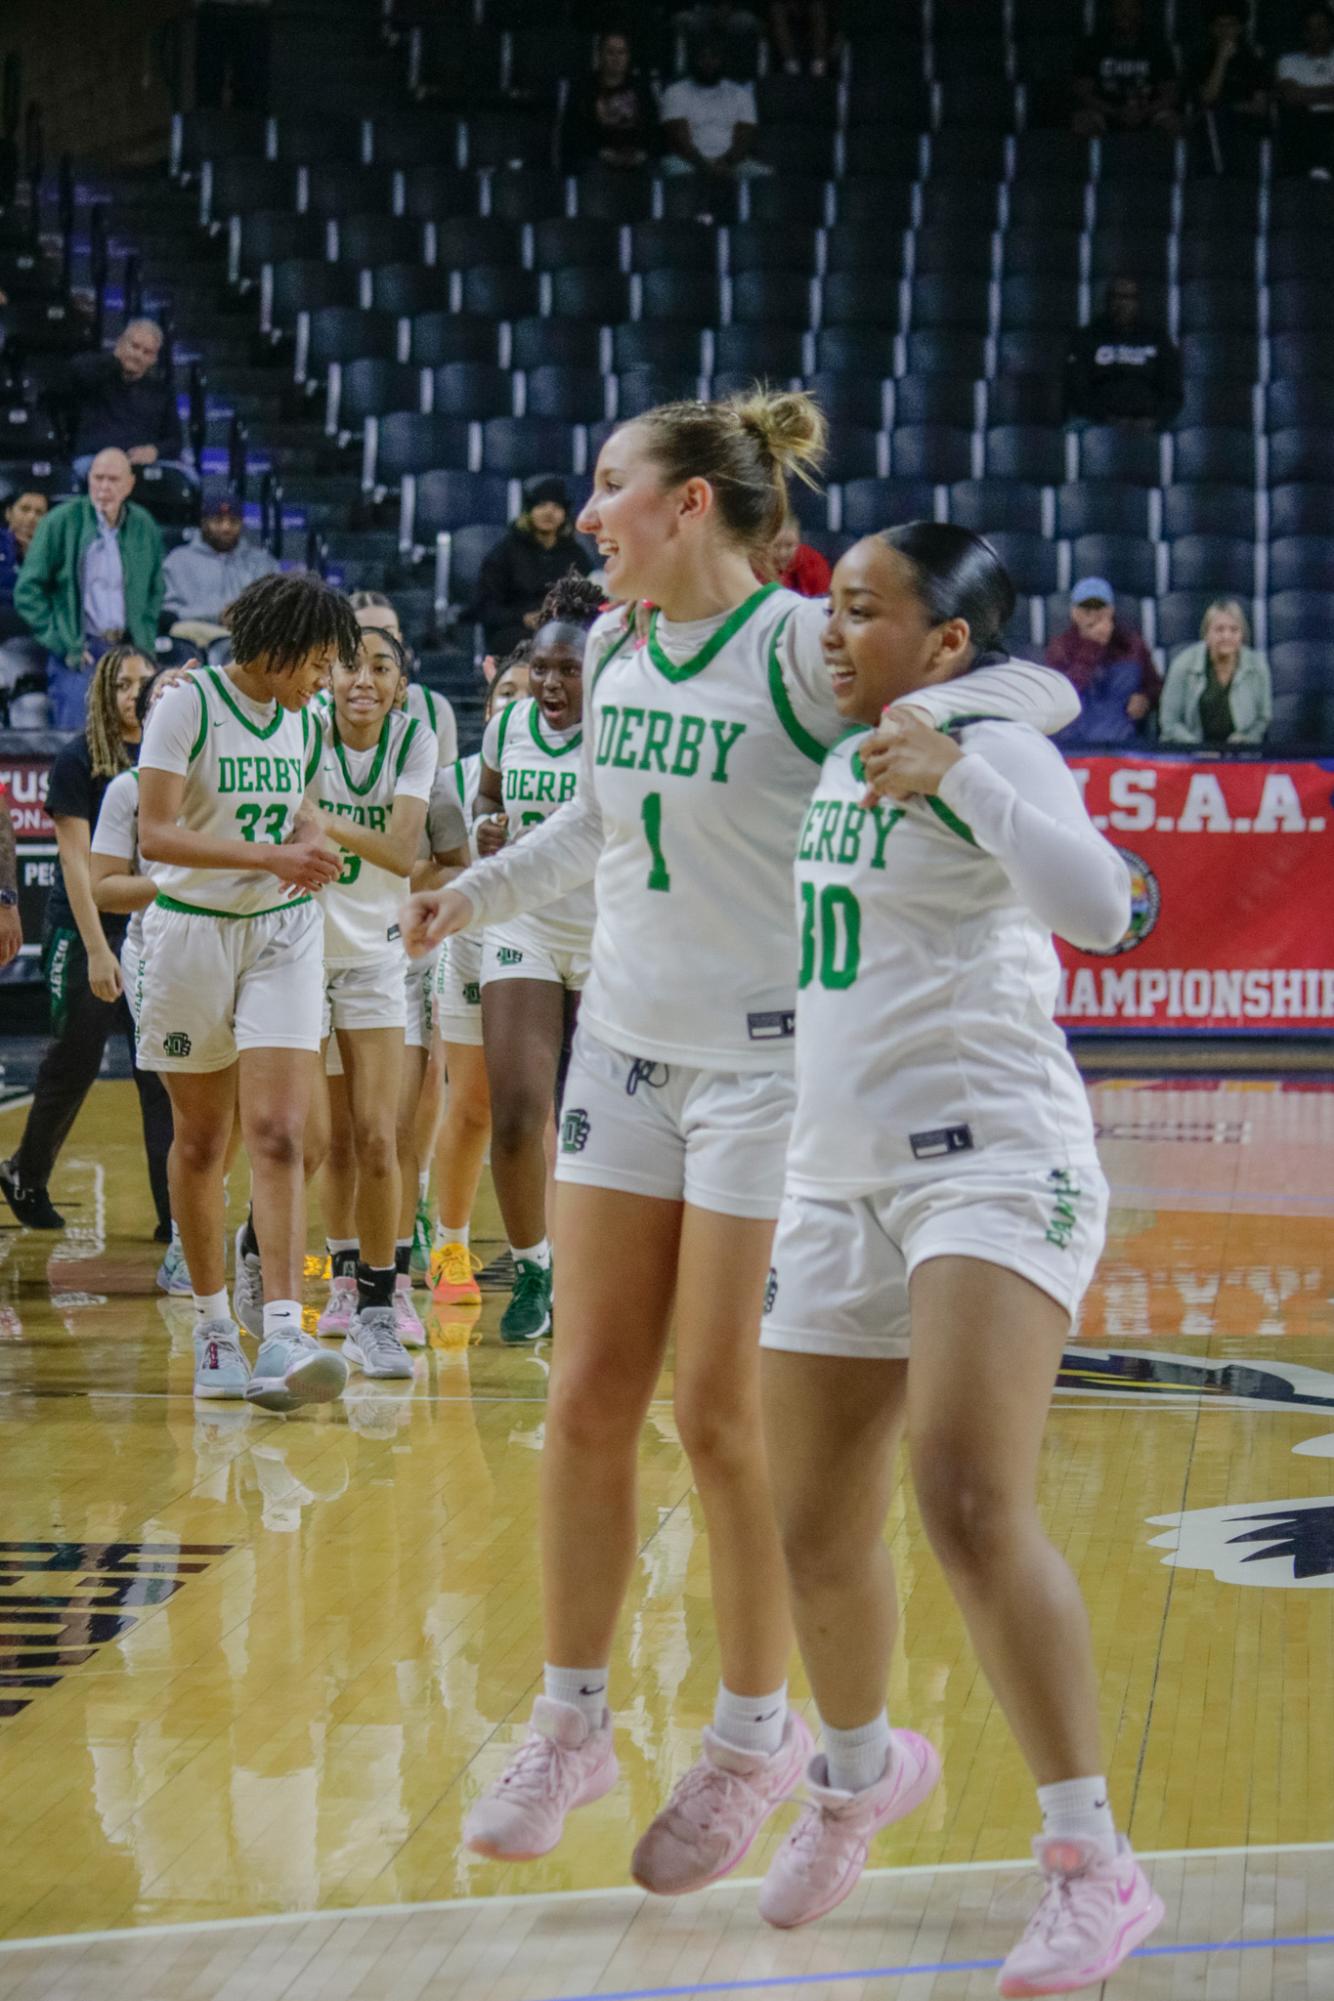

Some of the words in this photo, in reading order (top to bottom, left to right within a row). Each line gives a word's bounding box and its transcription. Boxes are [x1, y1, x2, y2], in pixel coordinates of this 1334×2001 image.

[595, 705, 747, 784] DERBY
[217, 757, 303, 794] DERBY
[505, 769, 577, 802] DERB
[235, 803, 289, 846] 33
[641, 792, 670, 892] 1
[796, 800, 907, 870] ERBY
